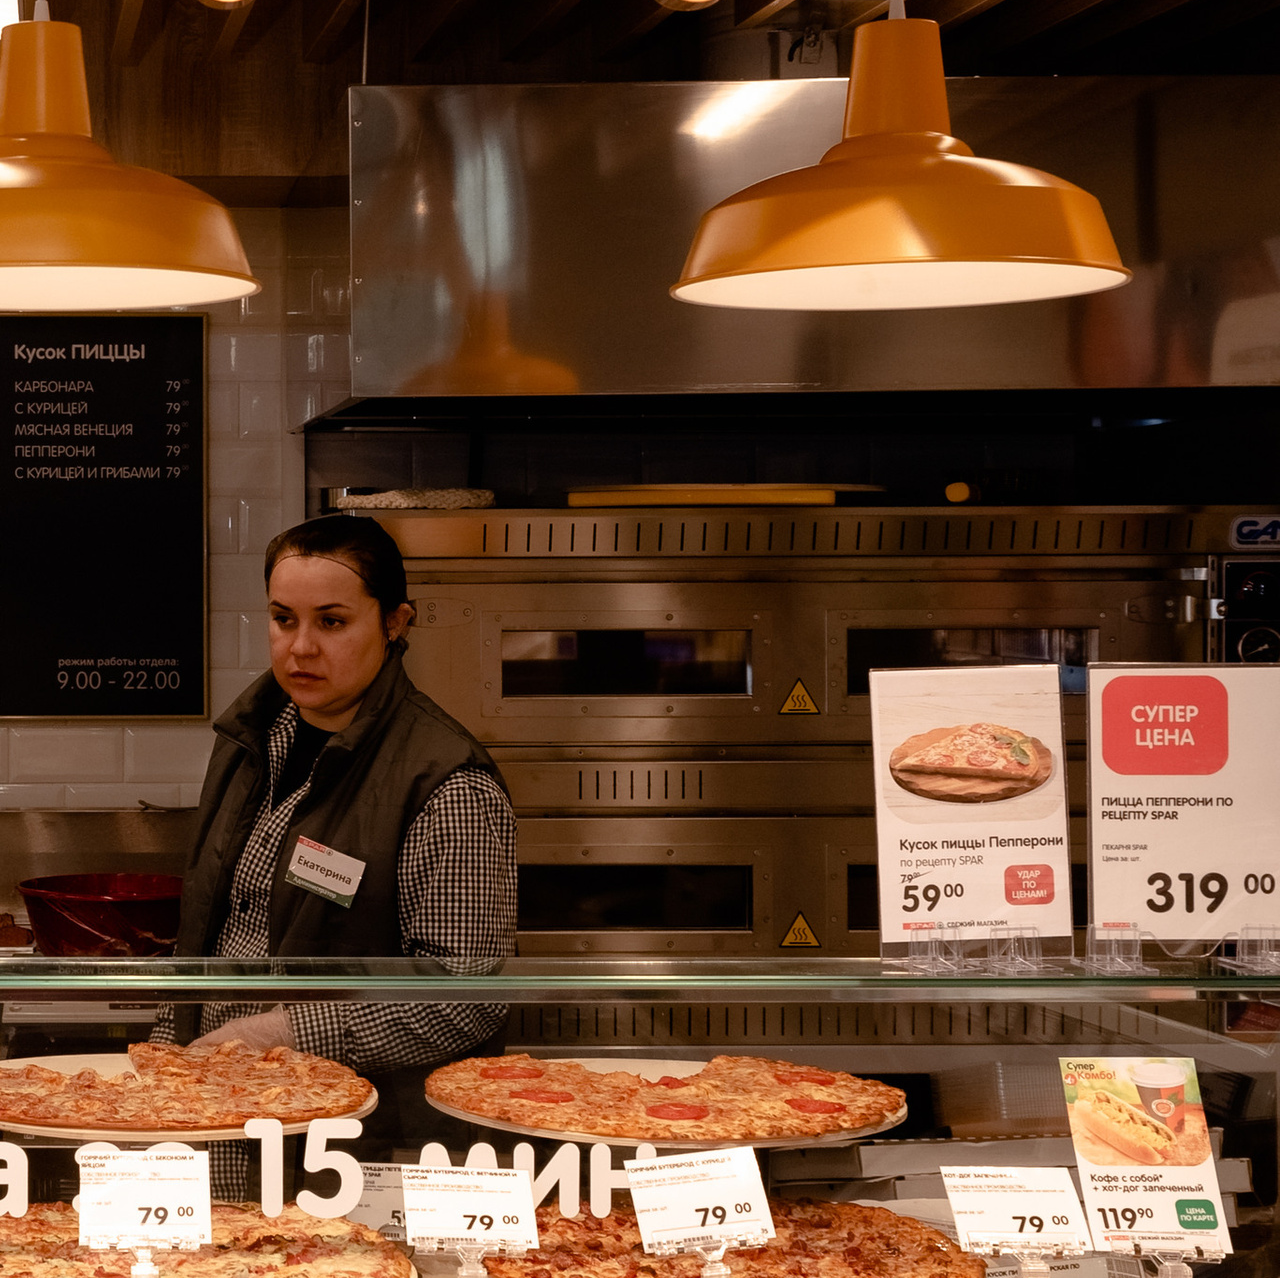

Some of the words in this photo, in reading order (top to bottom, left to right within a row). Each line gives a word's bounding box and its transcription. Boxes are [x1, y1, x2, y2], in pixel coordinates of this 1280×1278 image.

[14, 344, 66, 363] Кусок
[72, 344, 145, 362] ПИЦЦЫ
[14, 381, 94, 392] КАРБОНАРА
[166, 381, 181, 392] 79
[14, 403, 23, 414] С
[27, 401, 88, 416] КУРИЦЕЙ
[166, 403, 181, 414] 79
[14, 424, 70, 436] МЯСНАЯ
[74, 424, 133, 438] ВЕНЕЦИЯ
[166, 424, 181, 436] 79
[14, 446, 95, 457] ПЕППЕРОНИ
[166, 446, 181, 457] 79
[14, 467, 23, 478] С
[27, 465, 84, 481] КУРИЦЕЙ
[88, 467, 97, 478] И
[100, 467, 160, 478] ГРИБАМИ
[166, 467, 181, 478] 79
[58, 658, 95, 668] режим
[97, 658, 136, 668] работы
[139, 658, 179, 668] отдела:
[57, 672, 101, 690] 9.00
[124, 672, 180, 690] 22.00
[1131, 705, 1198, 723] СУПЕР
[1136, 729, 1194, 749] ЦЕНА
[1102, 797, 1143, 808] ПИЦЦА
[1146, 797, 1213, 806] ПЕППЕРОНИ
[1216, 797, 1233, 806] ПО
[1102, 811, 1147, 821] РЕЦЕПТУ
[1151, 811, 1178, 819] SPAR
[900, 839, 938, 853] Кусок
[941, 838, 985, 851] пиццы
[989, 836, 1063, 850] Пепперони
[297, 855, 352, 885] Екатерина
[900, 859, 913, 867] по
[915, 858, 957, 869] рецепту
[959, 856, 984, 865] SPAR
[1017, 870, 1040, 879] УДАР
[1012, 890, 1047, 899] ЦЕНАМ!
[1146, 872, 1228, 913] 319
[1244, 874, 1275, 894] 00
[1067, 1062, 1094, 1071] Супер
[1077, 1071, 1116, 1080] Комбо!
[245, 1118, 363, 1218] 15
[658, 1162, 694, 1171] БУТЕРБРОД
[1091, 1174, 1118, 1183] Кофе
[1102, 1185, 1138, 1193] хот-дог
[1143, 1183, 1204, 1193] запеченный
[138, 1207, 169, 1225] 79
[177, 1206, 194, 1217] 00
[695, 1206, 726, 1227] 79
[735, 1202, 751, 1213] 00
[1097, 1208, 1137, 1229] 119
[463, 1215, 494, 1230] 79
[503, 1215, 519, 1224] 00
[1012, 1216, 1044, 1233] 79
[1052, 1215, 1068, 1225] 00
